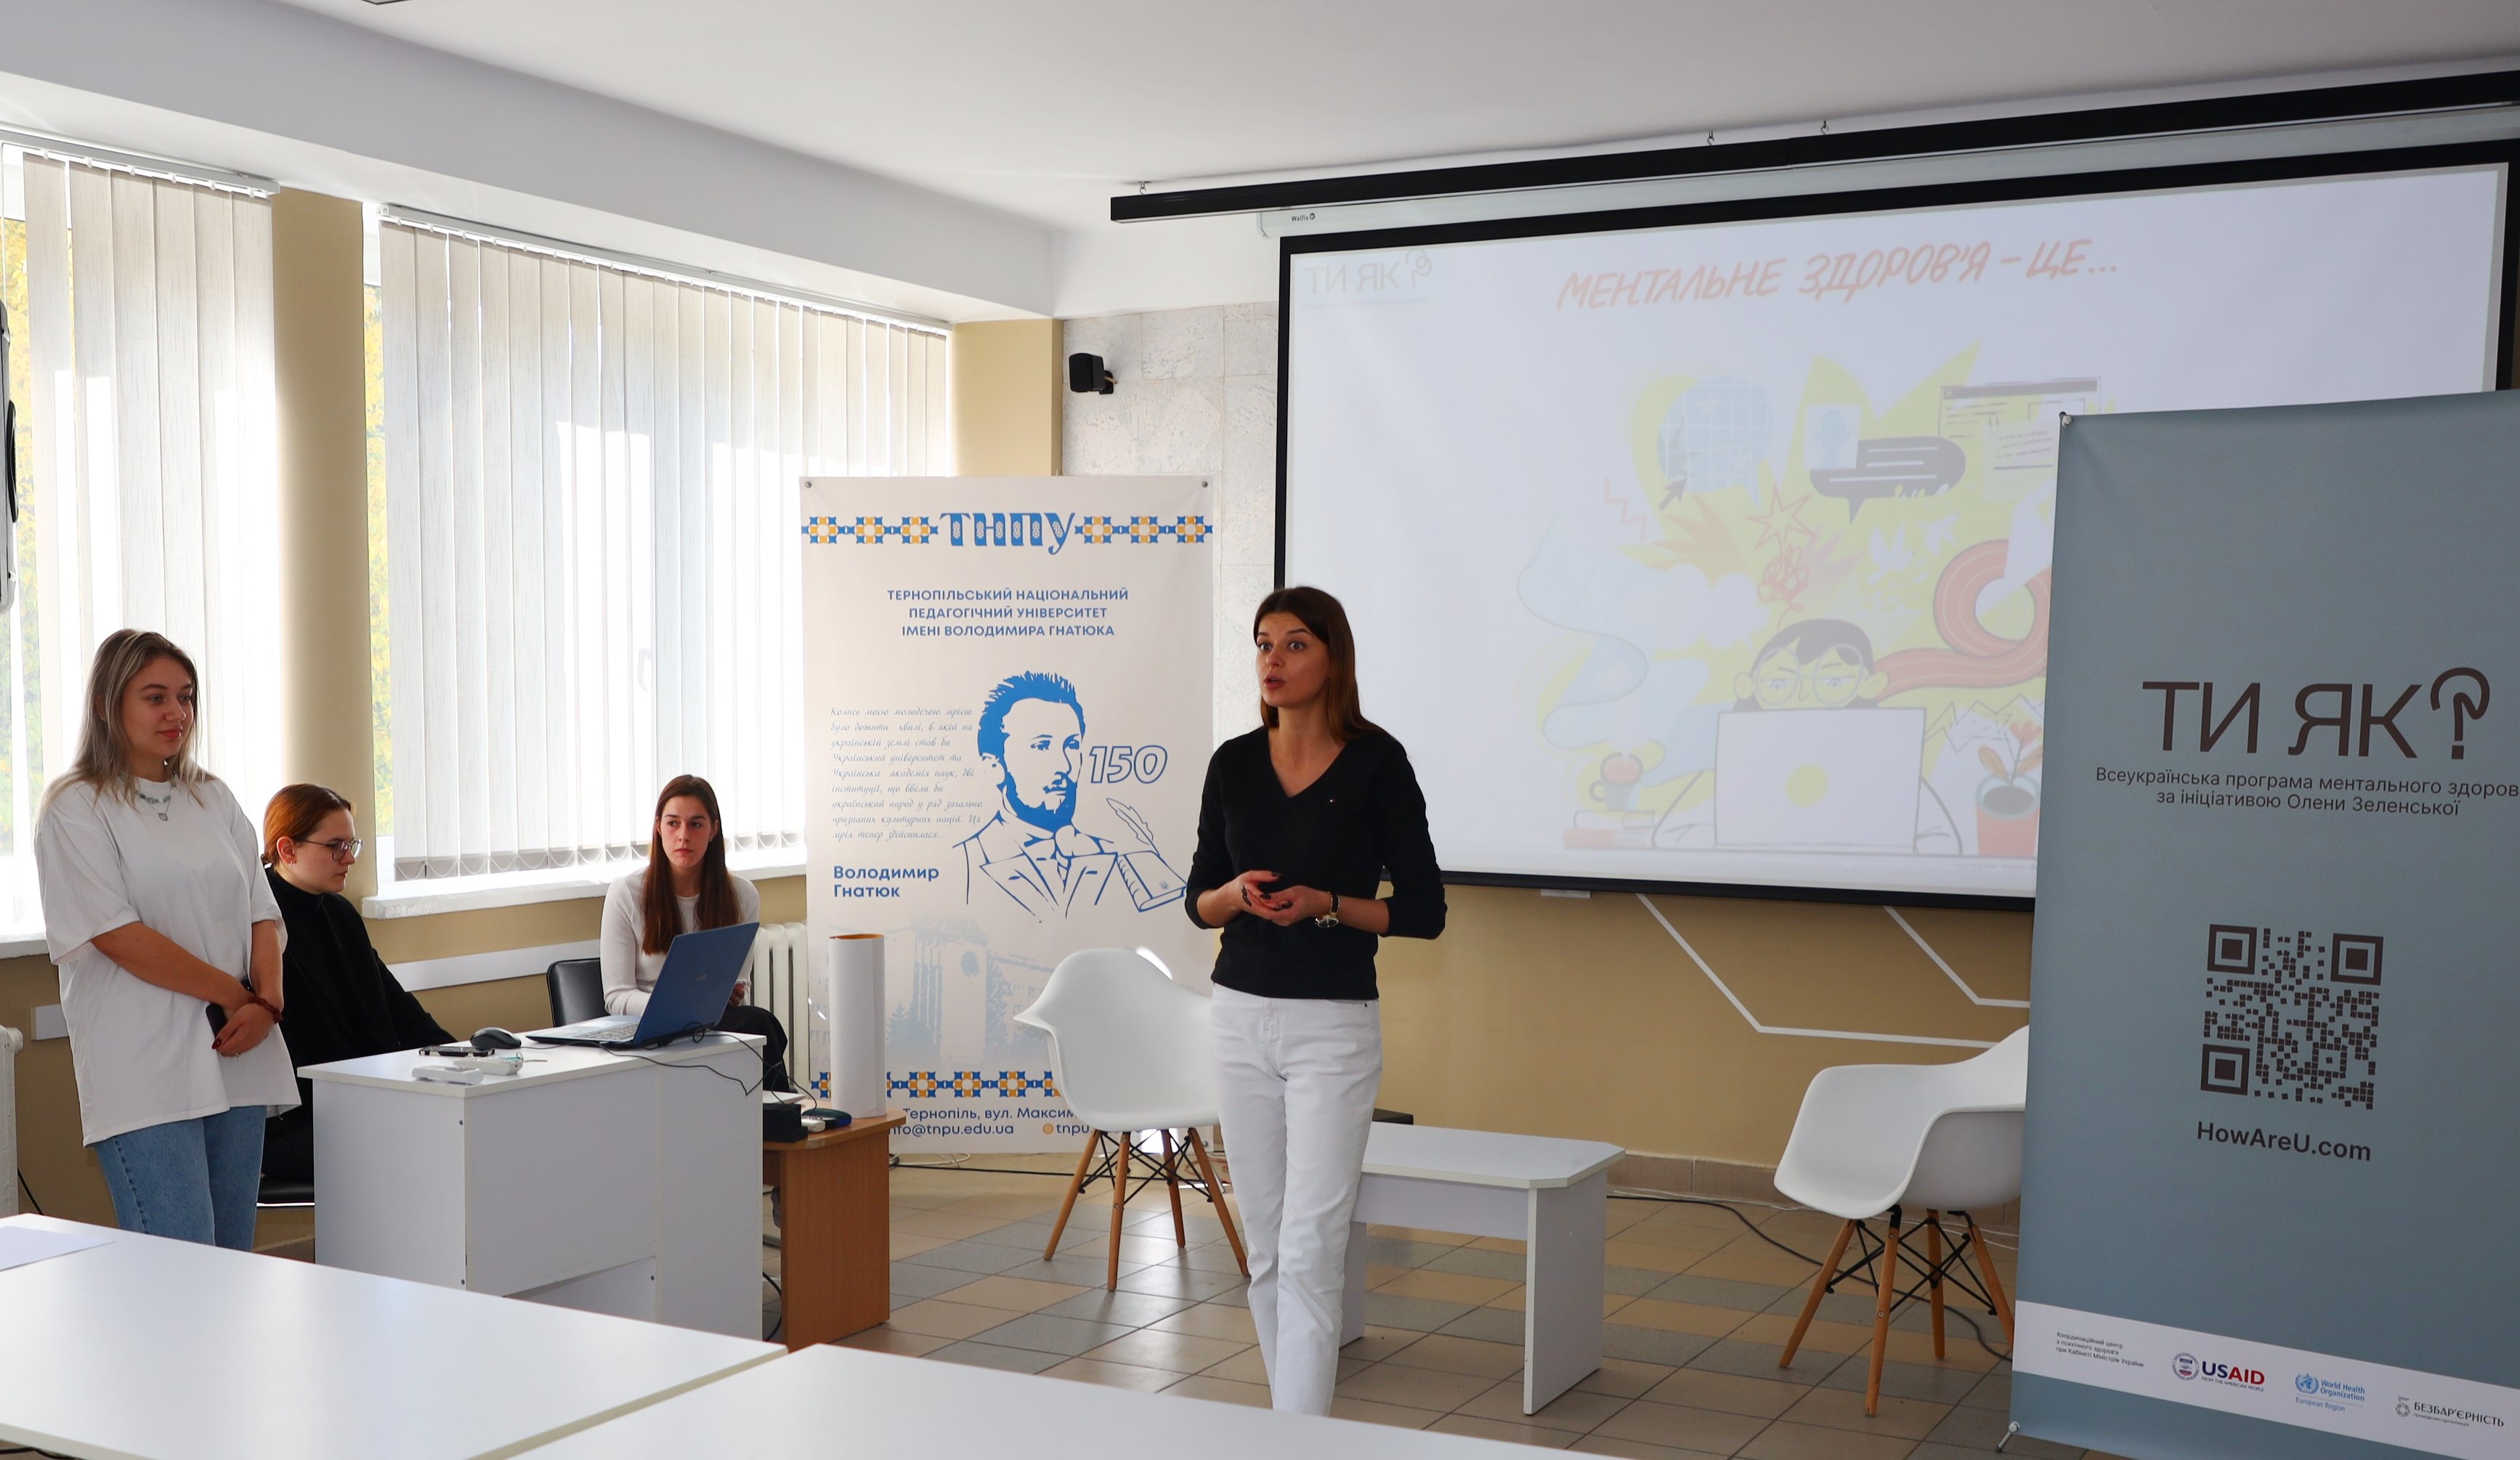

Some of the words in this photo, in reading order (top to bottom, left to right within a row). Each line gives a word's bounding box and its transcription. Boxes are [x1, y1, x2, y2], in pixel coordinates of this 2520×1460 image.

[1304, 264, 1348, 295] ТИ
[1556, 257, 1788, 312] МЕНТАЛЬНЕ
[939, 512, 1076, 556] ТНПУ
[887, 588, 1012, 601] ТЕРНОПІЛЬСЬКИЙ
[1016, 588, 1128, 602] НАЦІОНАЛЬНИЙ
[909, 605, 1014, 620] ПЕДАГОГІЧНИЙ
[1017, 607, 1108, 619] УНІВЕРСИТЕТ
[902, 625, 941, 637] ІМЕНІ
[944, 625, 1045, 638] ВОЛОДИМИРА
[1049, 625, 1114, 637] ГНАТЮКА
[2142, 681, 2261, 754] ТИ
[1088, 744, 1168, 784] 150
[2096, 767, 2220, 787] Всеукраїнська
[2226, 774, 2313, 790] програма
[2319, 777, 2442, 795] ментального
[2156, 792, 2176, 804] за
[2180, 789, 2281, 810] ініціативою
[2287, 794, 2346, 811] Олени
[2351, 797, 2461, 816] Зеленської
[833, 866, 939, 882] Володимир
[833, 884, 901, 898] Гнатюк
[984, 1109, 1013, 1122] вул.
[889, 1124, 1014, 1137] nfo@tnpu.edu.ua
[2197, 1121, 2371, 1161] HowAreU.com
[2202, 1360, 2265, 1385] USAID
[2320, 1388, 2365, 1401] Organization
[2321, 1379, 2341, 1390] World
[2343, 1384, 2365, 1394] Health
[2296, 1397, 2323, 1408] European
[2325, 1403, 2346, 1412] Region
[2414, 1402, 2505, 1427] БЕЗБАР'ЄРНІСТЬ
